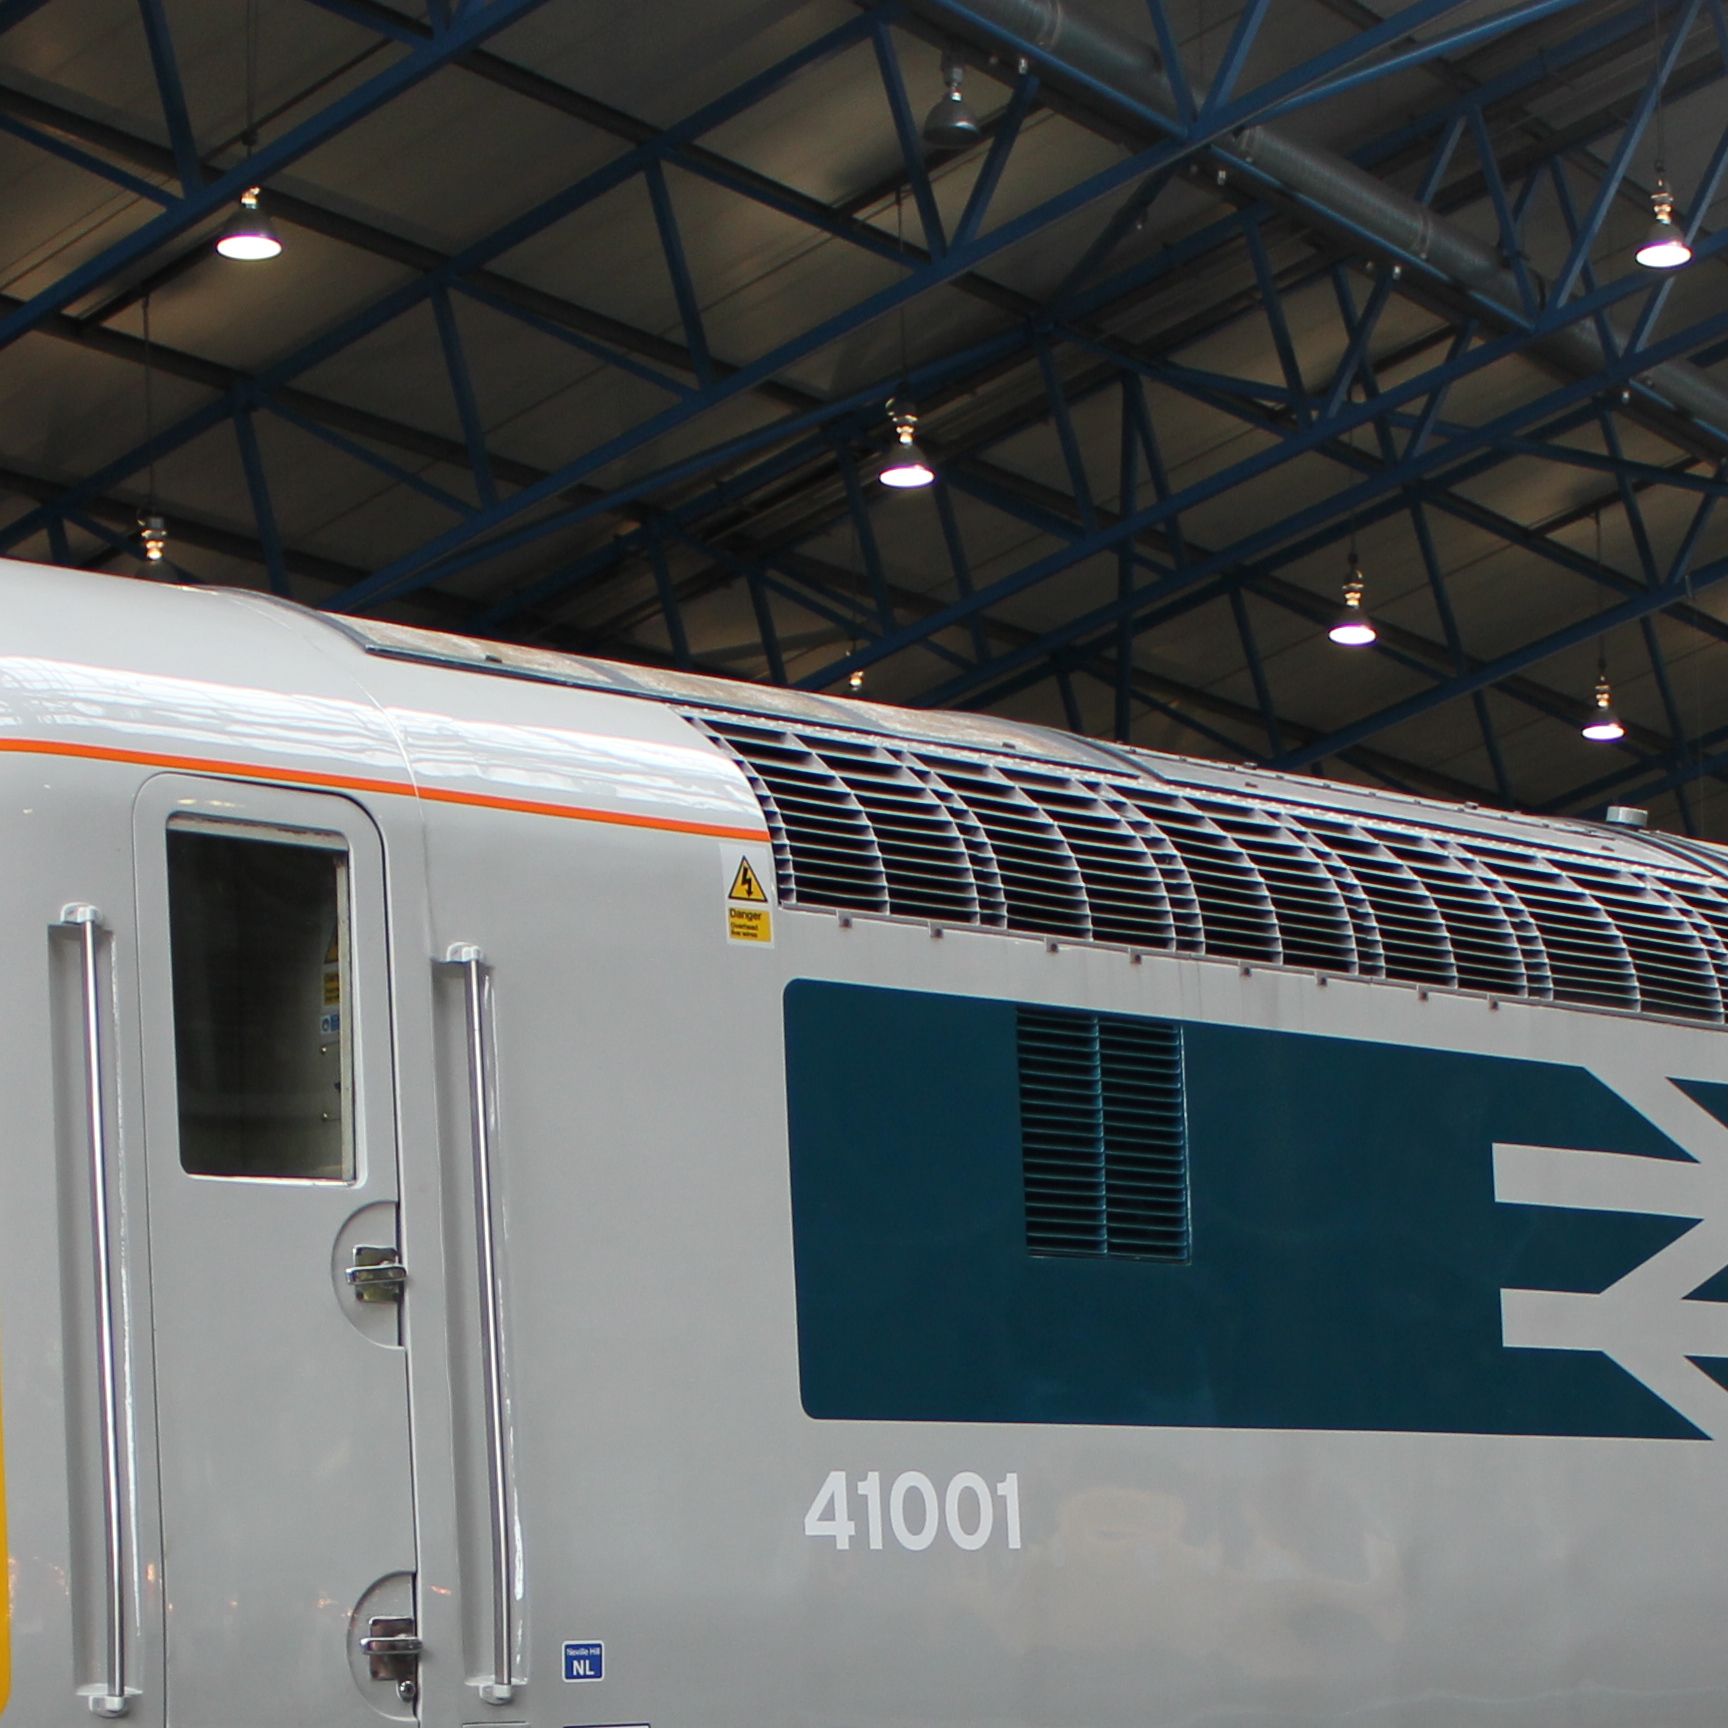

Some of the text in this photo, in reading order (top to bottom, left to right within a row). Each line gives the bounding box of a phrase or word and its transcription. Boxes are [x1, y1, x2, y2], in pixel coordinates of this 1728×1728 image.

[729, 908, 761, 921] Danger
[804, 1471, 1021, 1550] 41001
[572, 1659, 596, 1676] NL
